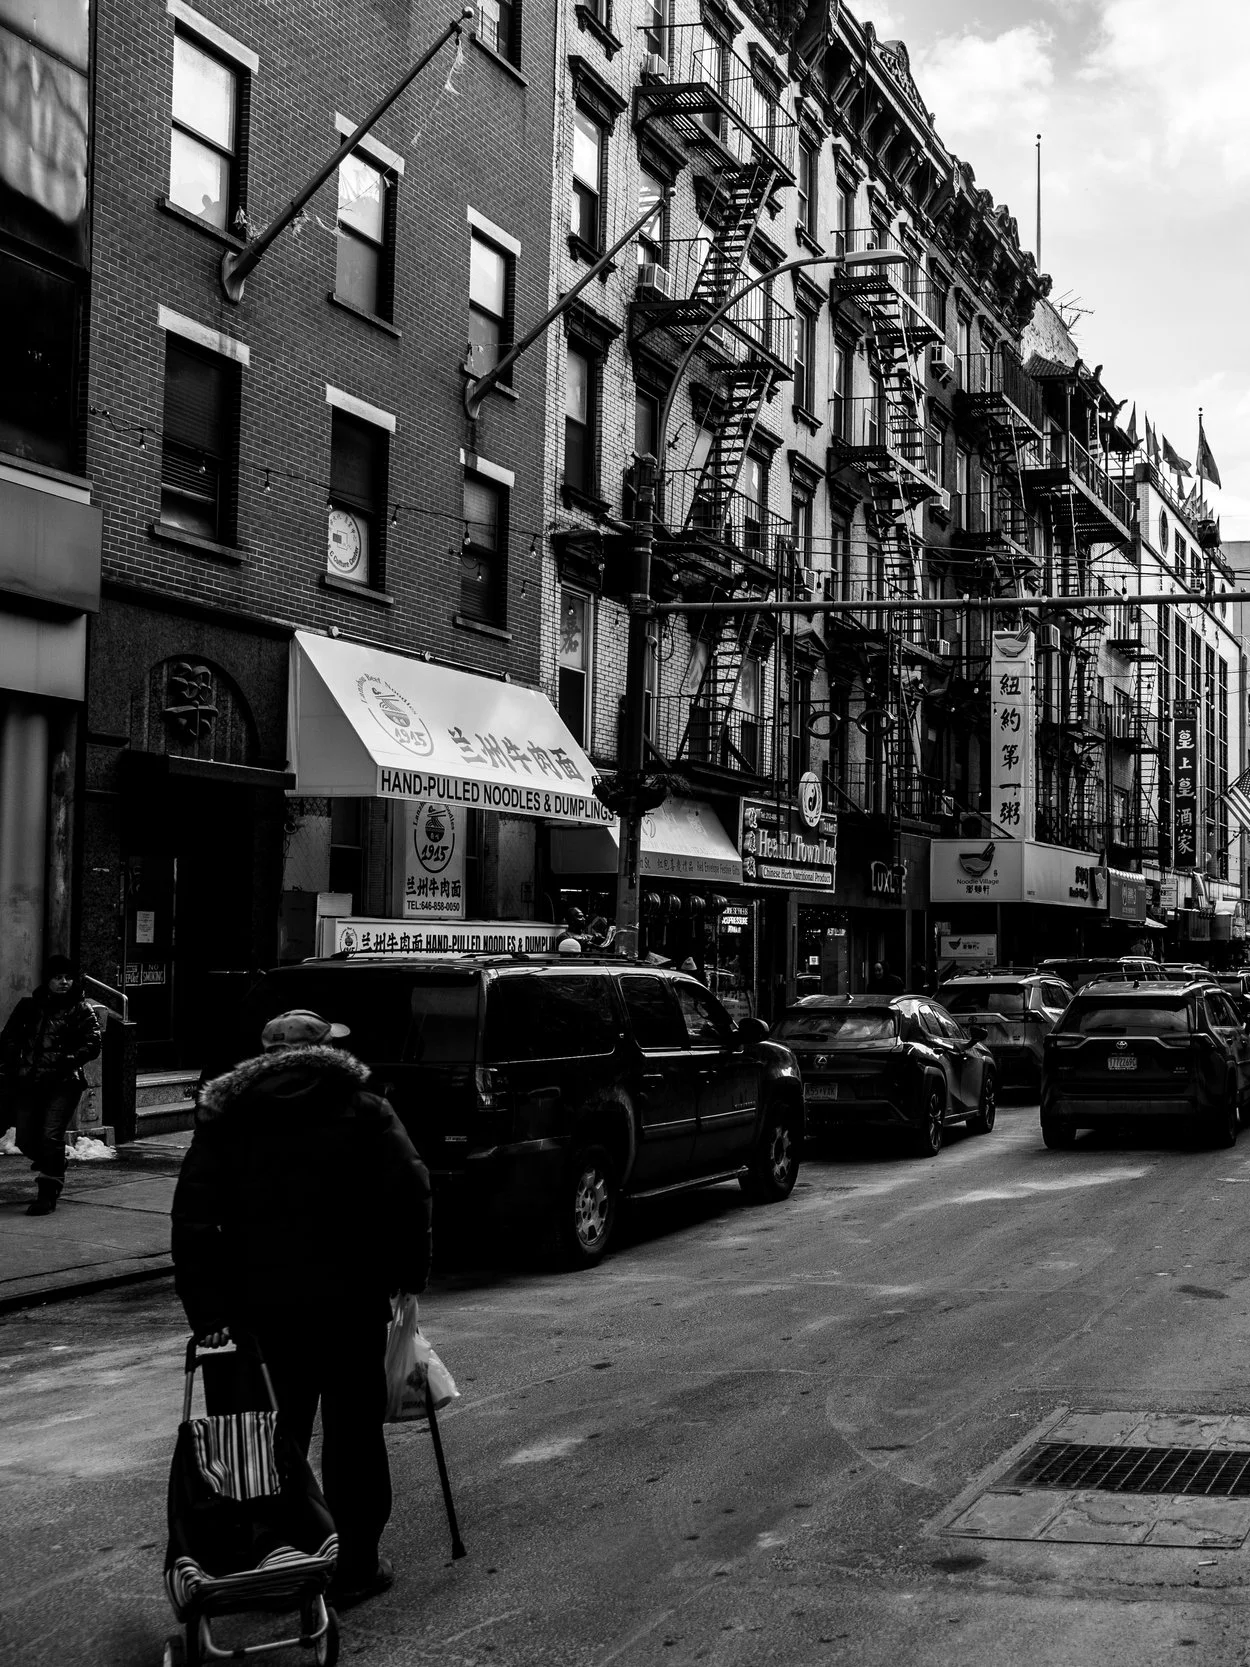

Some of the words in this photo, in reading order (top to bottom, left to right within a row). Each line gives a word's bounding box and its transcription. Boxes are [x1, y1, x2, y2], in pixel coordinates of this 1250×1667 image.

[395, 728, 427, 748] 1915
[448, 726, 585, 782] 兰州牛肉面
[999, 673, 1022, 826] 紐約第一粥
[381, 770, 480, 803] HAND-PULLED
[484, 784, 541, 812] NOODLES
[544, 794, 552, 813] &
[555, 795, 614, 822] DUMPLINGS
[421, 844, 450, 862] 1915
[794, 834, 820, 863] Town
[763, 866, 780, 878] Chinese
[781, 868, 792, 879] Herb
[980, 878, 999, 886] Village
[406, 876, 462, 898] 兰州牛肉面
[407, 900, 460, 911] TEL:646-858-0050
[361, 932, 423, 953] 兰州牛肉面
[426, 934, 481, 953] HAND-PULLED
[483, 935, 516, 953] NOODLES
[518, 937, 523, 951] &
[143, 971, 164, 982] SMOKING
